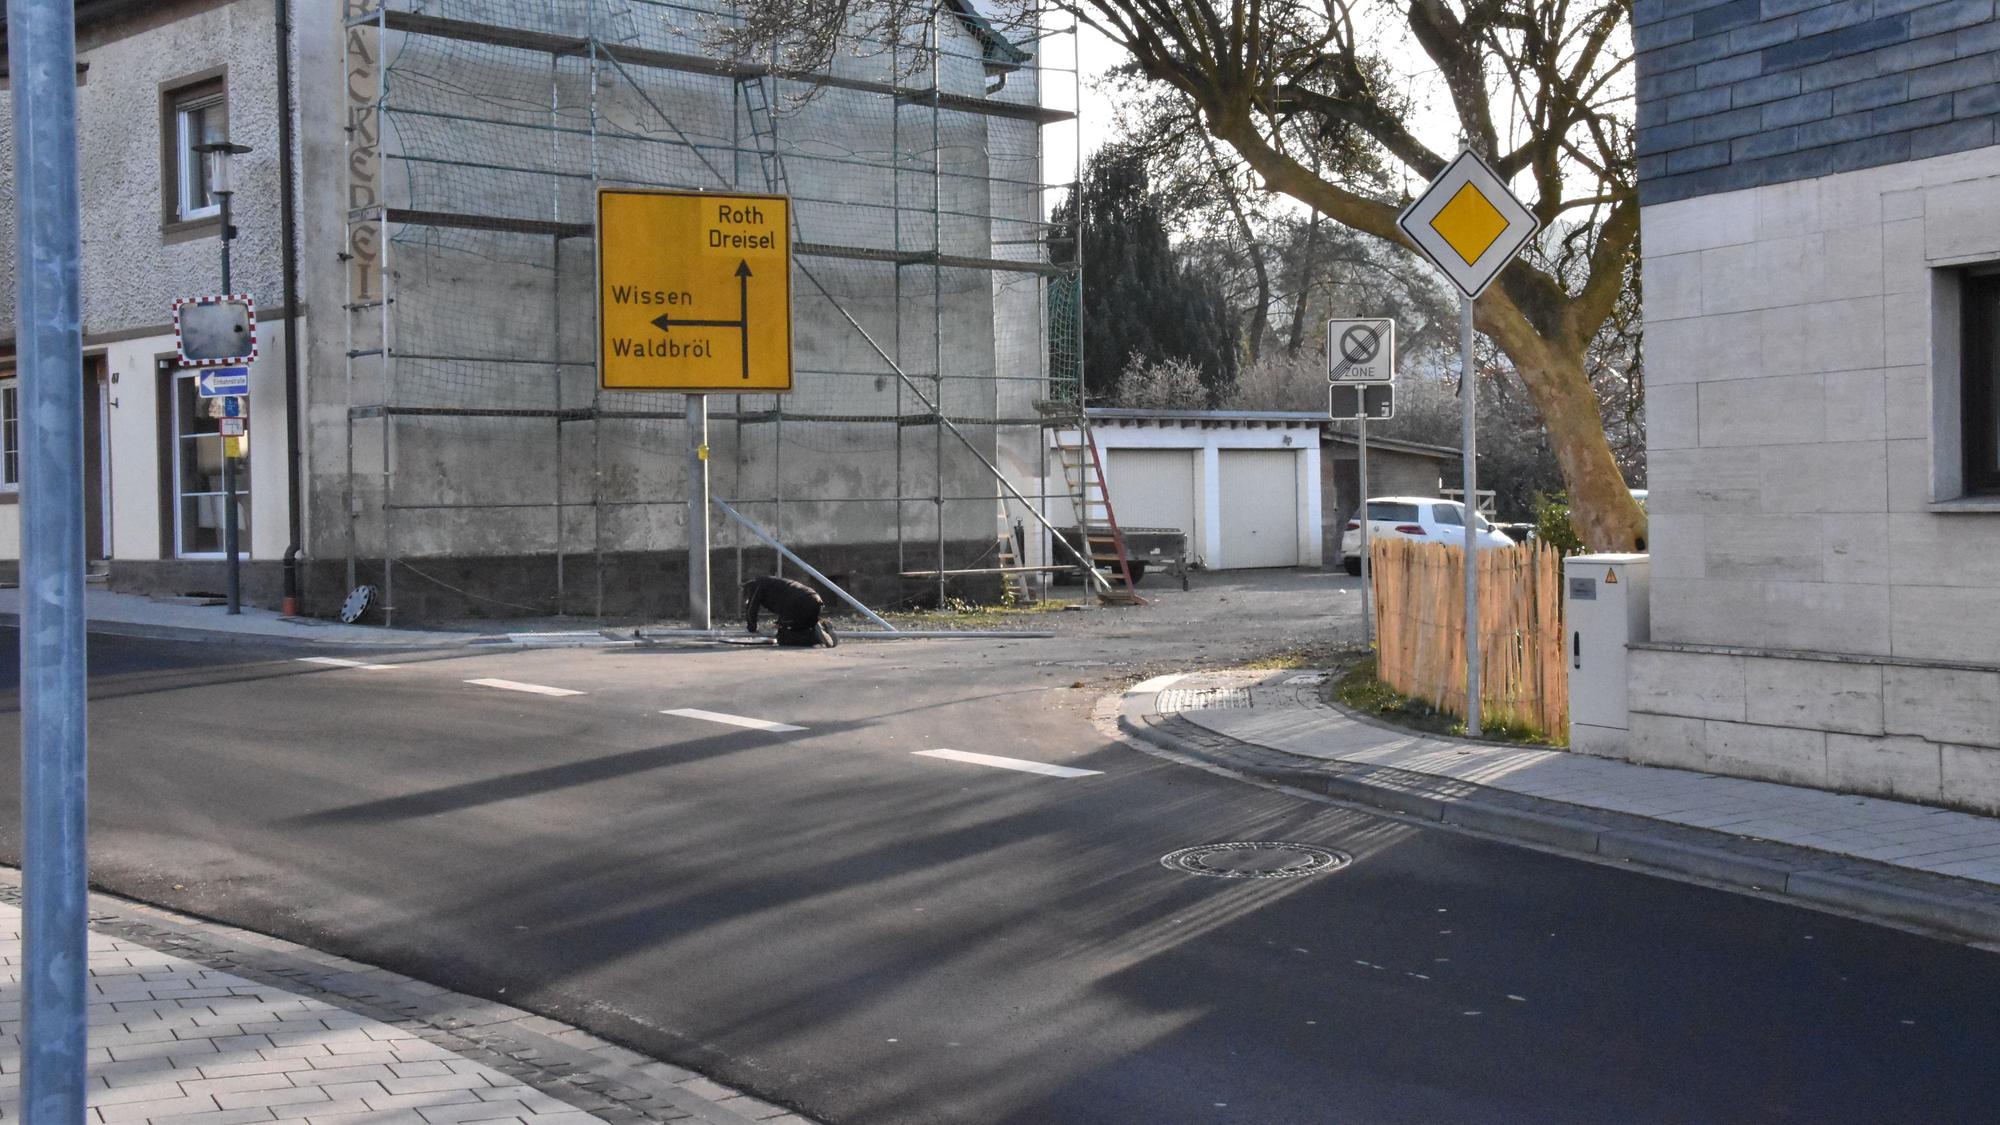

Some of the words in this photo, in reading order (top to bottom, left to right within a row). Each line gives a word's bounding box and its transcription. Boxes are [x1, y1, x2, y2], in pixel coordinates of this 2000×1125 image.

[719, 205, 763, 224] Roth
[709, 229, 775, 249] Dreisel
[612, 285, 692, 305] Wissen
[612, 337, 712, 358] Waldbröl
[1345, 366, 1375, 377] ZONE
